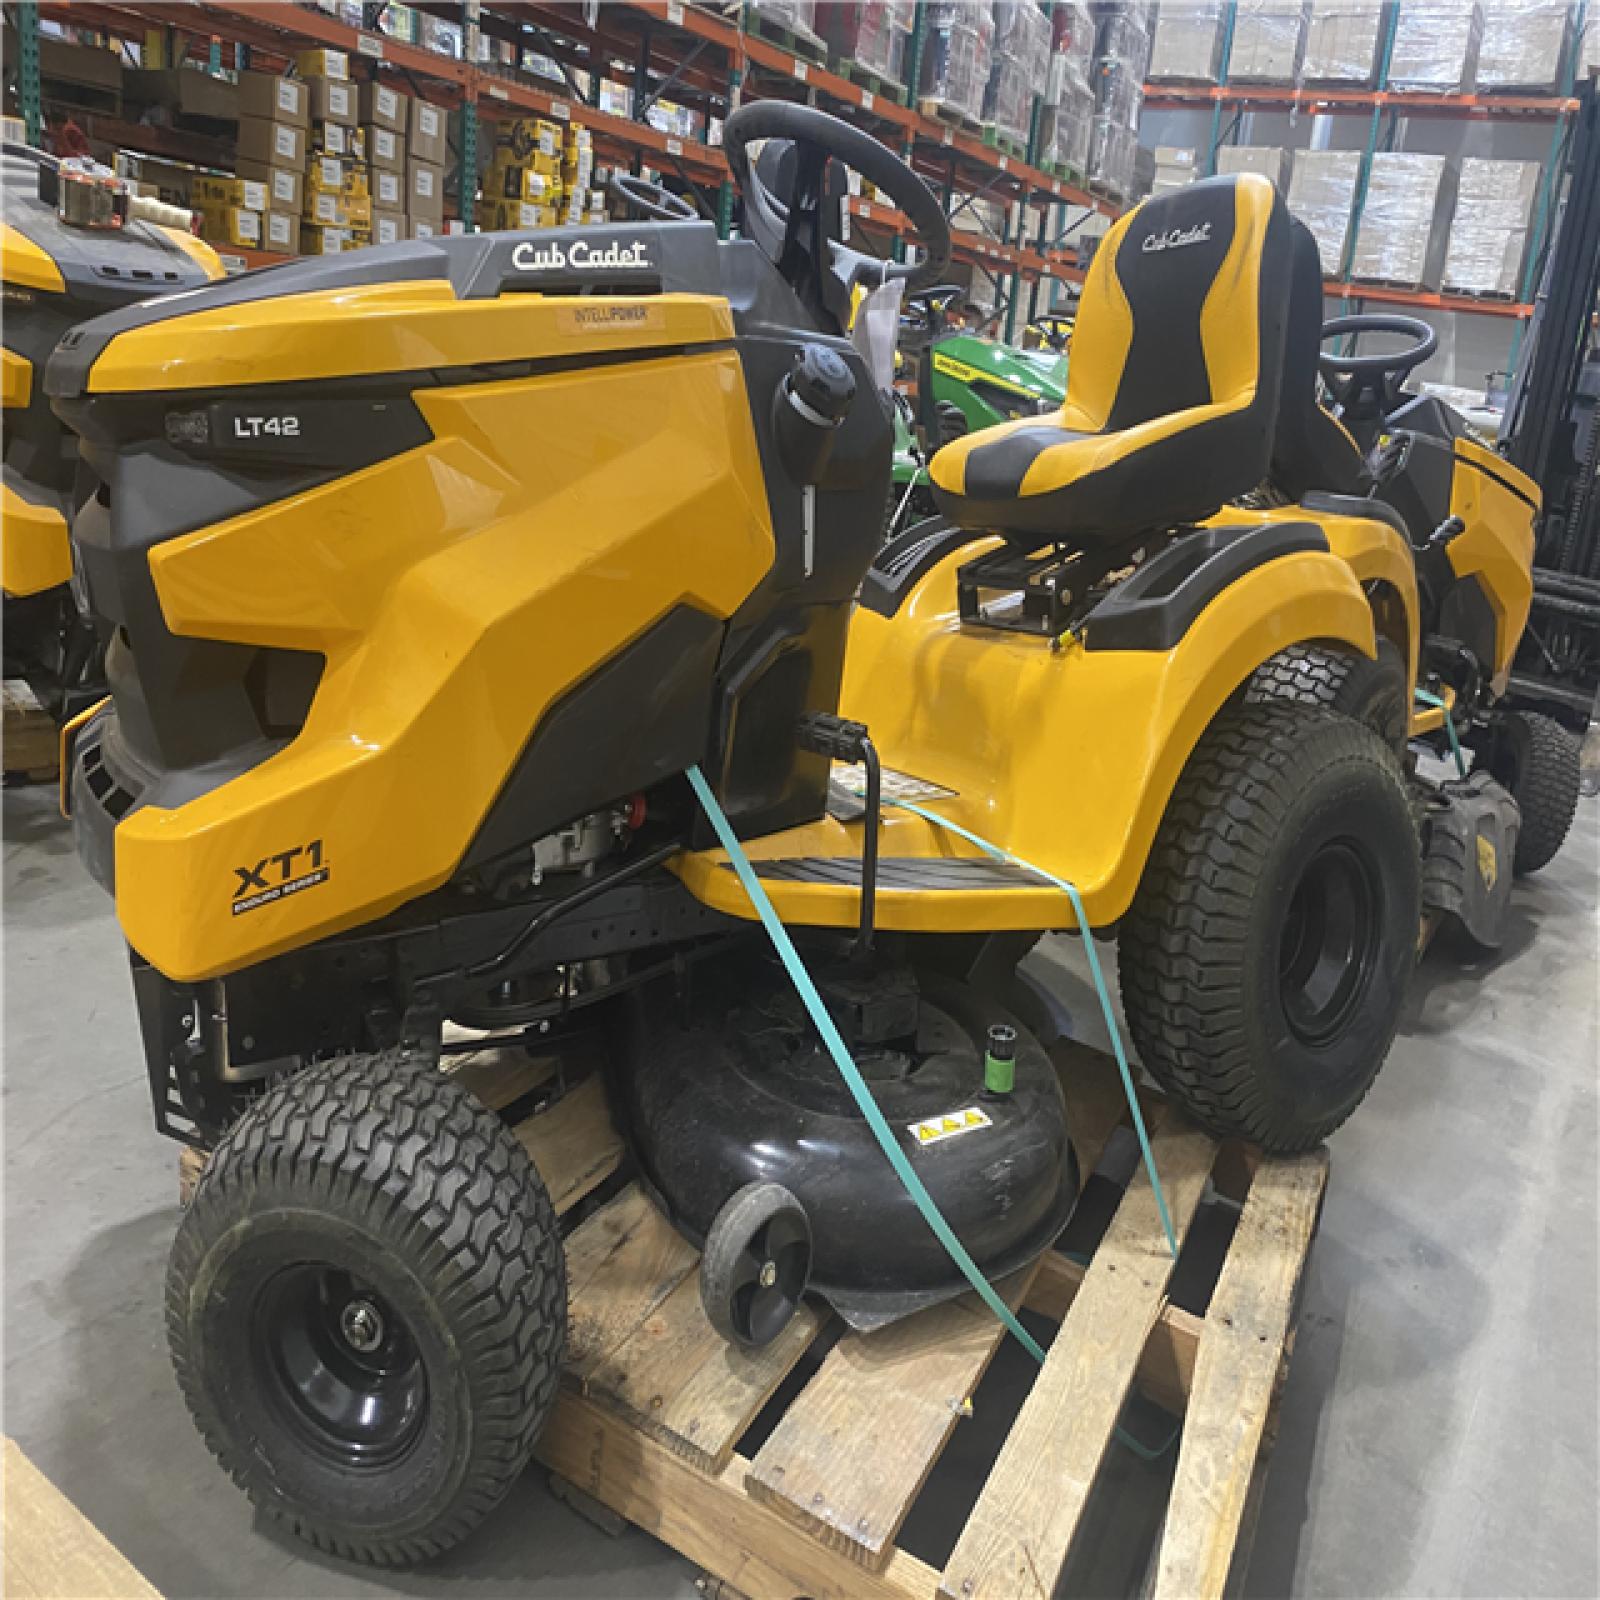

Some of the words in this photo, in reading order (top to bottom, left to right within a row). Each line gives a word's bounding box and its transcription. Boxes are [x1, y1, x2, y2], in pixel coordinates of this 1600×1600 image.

[512, 241, 566, 270] Cub
[568, 240, 649, 268] Cadet
[234, 416, 300, 437] LT42
[233, 839, 322, 897] XT1
